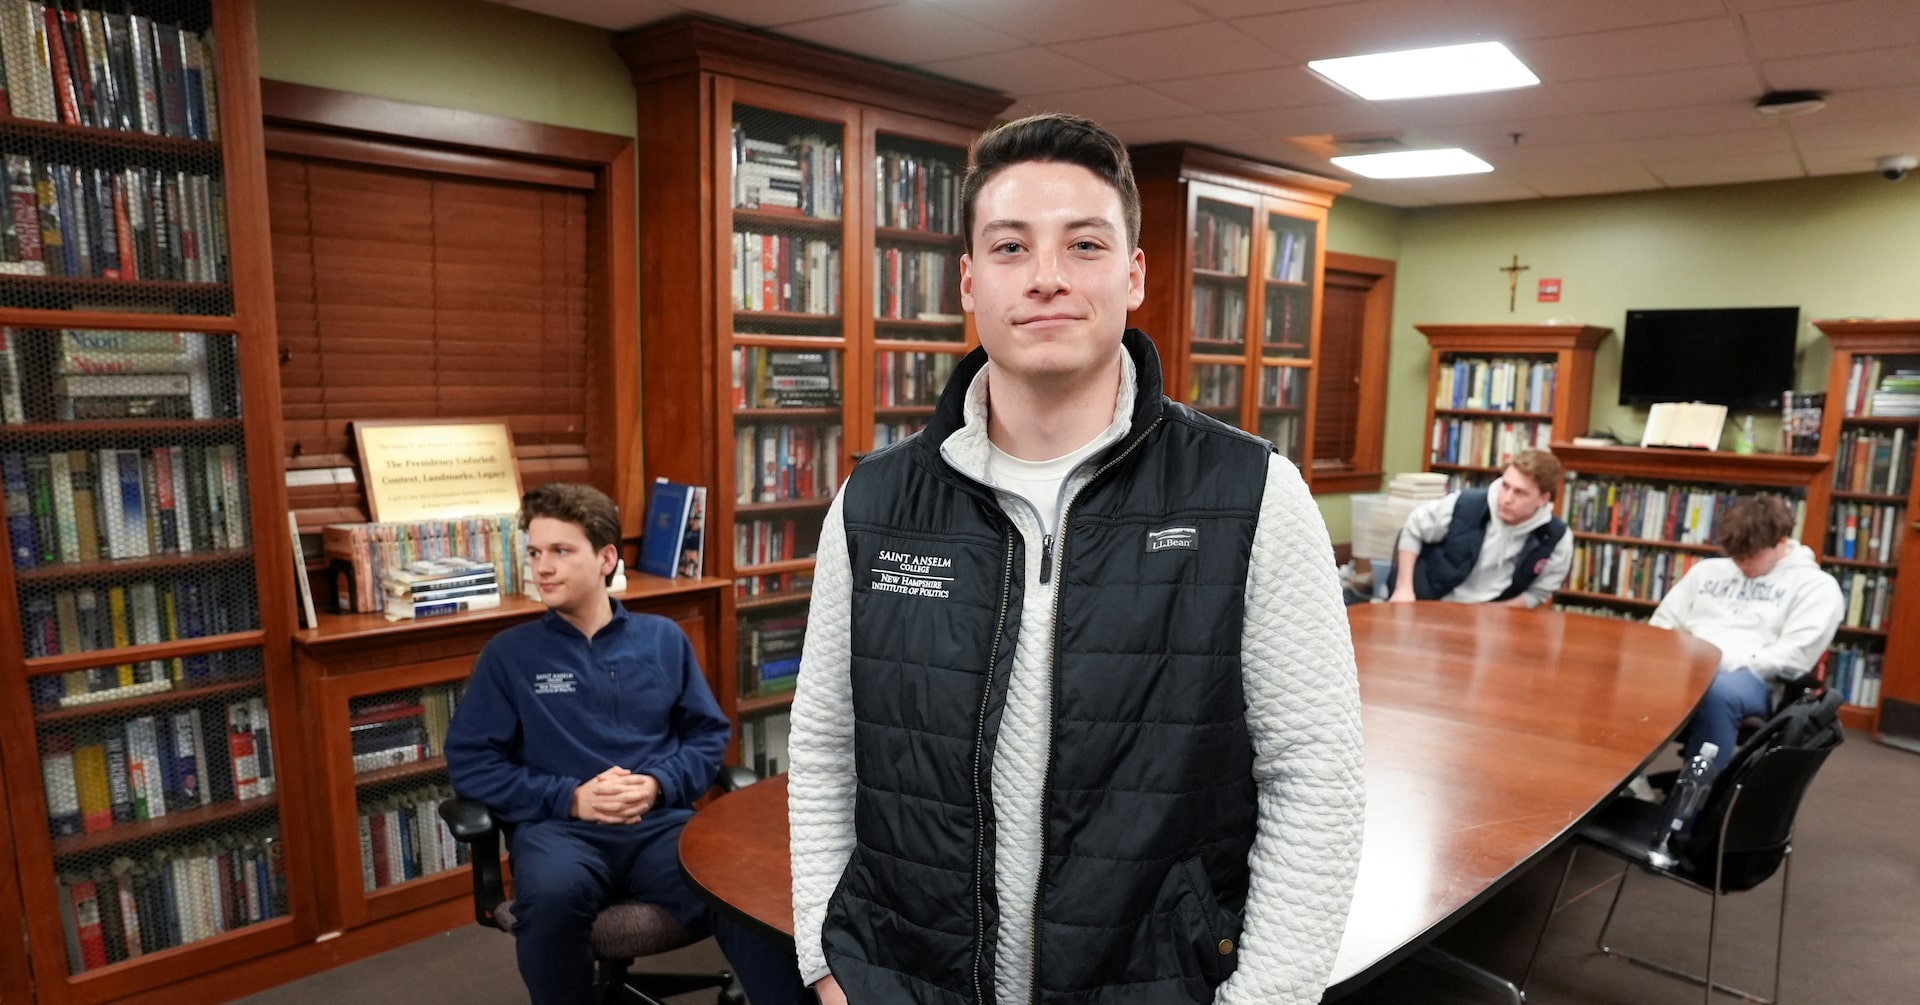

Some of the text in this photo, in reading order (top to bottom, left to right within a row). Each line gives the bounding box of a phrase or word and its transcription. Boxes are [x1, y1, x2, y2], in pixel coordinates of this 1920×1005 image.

[385, 459, 402, 469] The
[405, 457, 454, 469] Presidency
[381, 475, 421, 485] Context,
[477, 470, 506, 480] Legacy
[879, 550, 952, 568] SAINT ANSELM
[900, 563, 930, 573] COLLEGE
[880, 573, 943, 589] NEW HAMPSHIRE
[871, 582, 949, 599] INSTITUTE OF POLITICS
